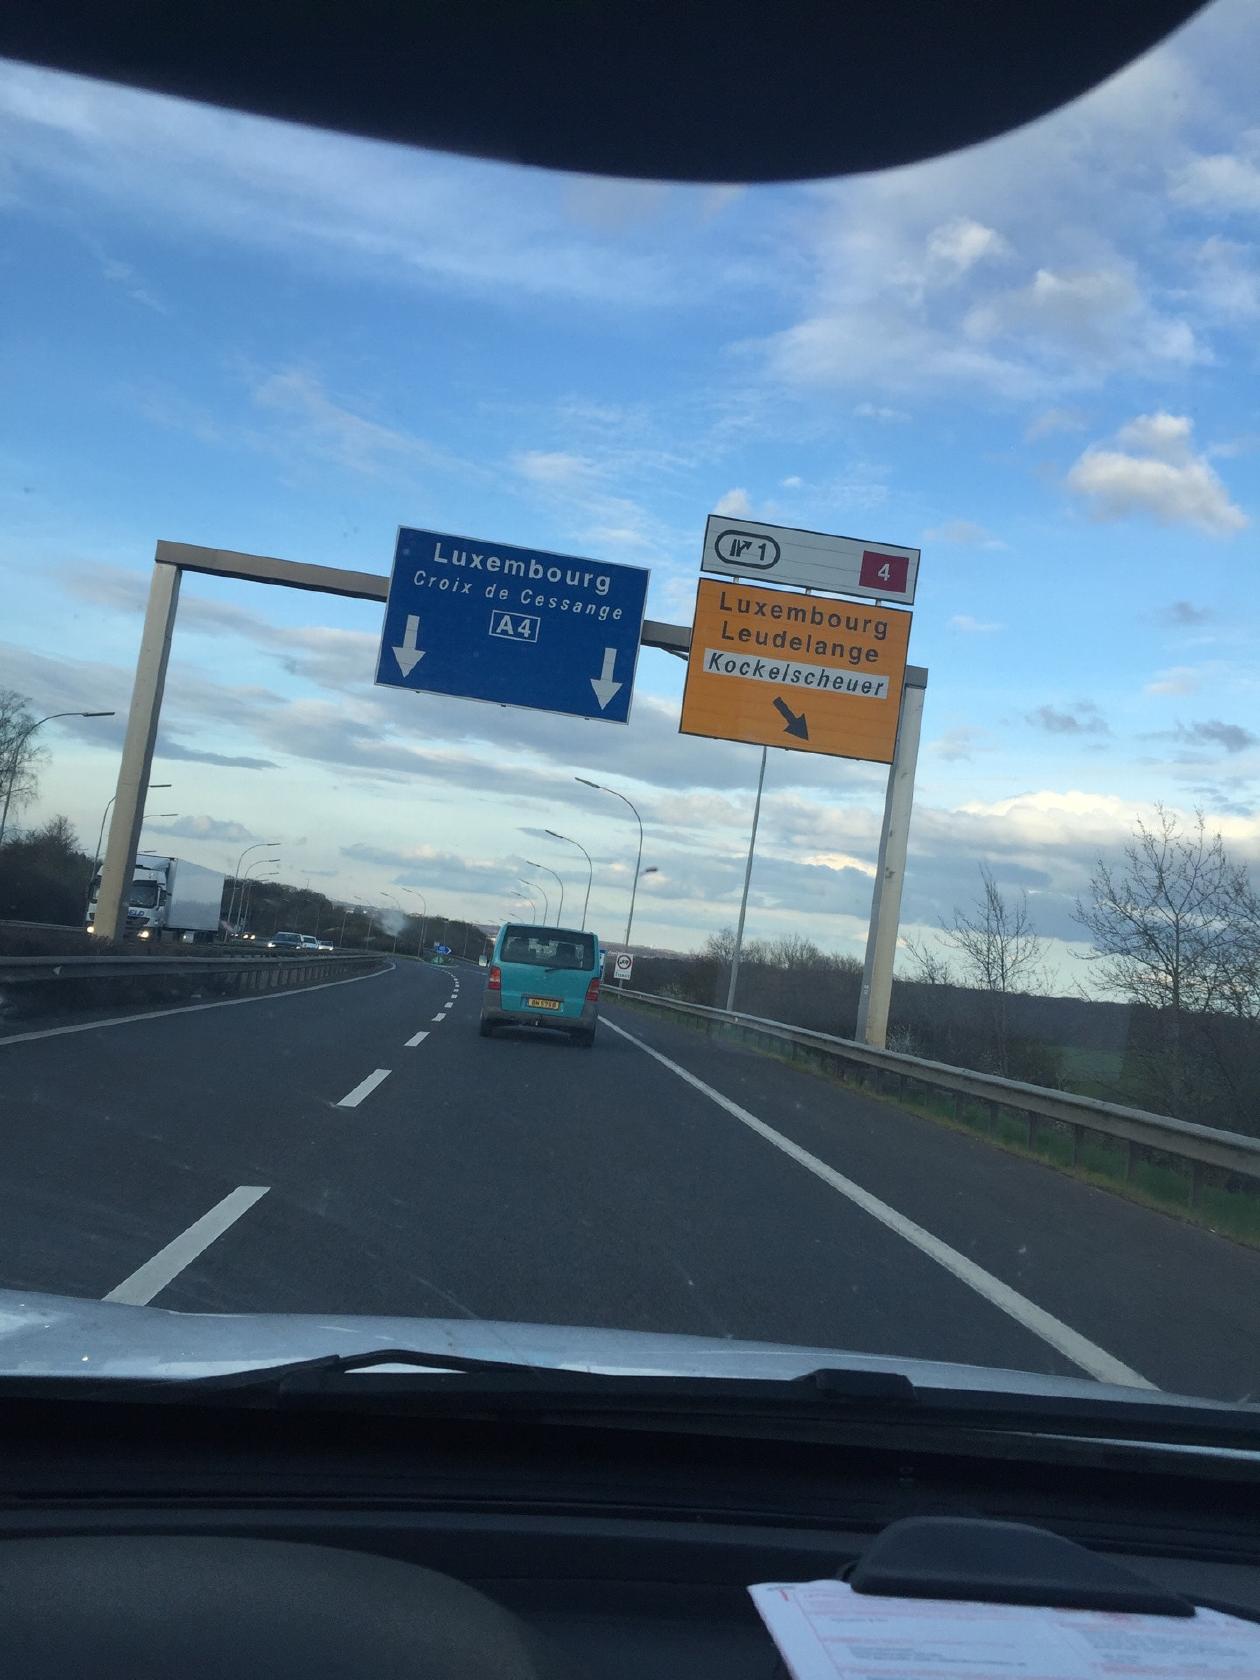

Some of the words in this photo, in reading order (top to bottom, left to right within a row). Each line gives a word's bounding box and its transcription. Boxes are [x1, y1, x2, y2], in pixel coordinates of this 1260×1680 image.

[433, 542, 611, 595] Luxembourg
[758, 544, 767, 561] 1
[877, 563, 890, 581] 4
[413, 570, 473, 594] Croix
[485, 583, 509, 600] de
[520, 589, 623, 621] Cessange
[719, 591, 888, 641] Luxembourg
[496, 614, 532, 638] A4
[721, 620, 879, 665] Leudelange
[708, 652, 885, 696] Kockelscheuer
